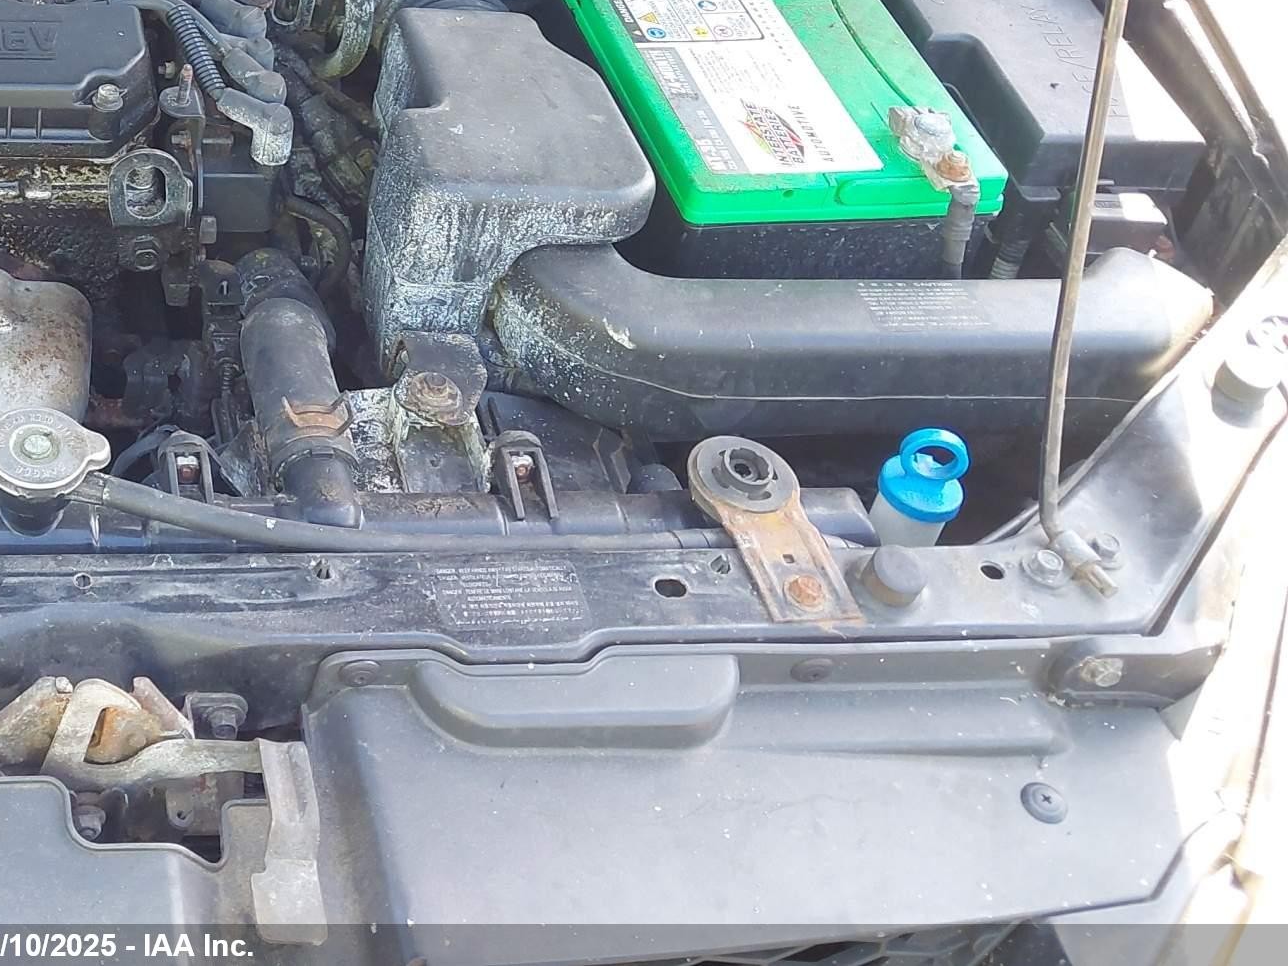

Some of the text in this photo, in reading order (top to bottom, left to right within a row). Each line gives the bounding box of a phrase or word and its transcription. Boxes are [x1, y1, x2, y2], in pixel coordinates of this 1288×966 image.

[744, 101, 793, 166] INTERSTATE
[760, 107, 805, 164] BATTERIES
[787, 105, 834, 162] AUTOMOTIVE
